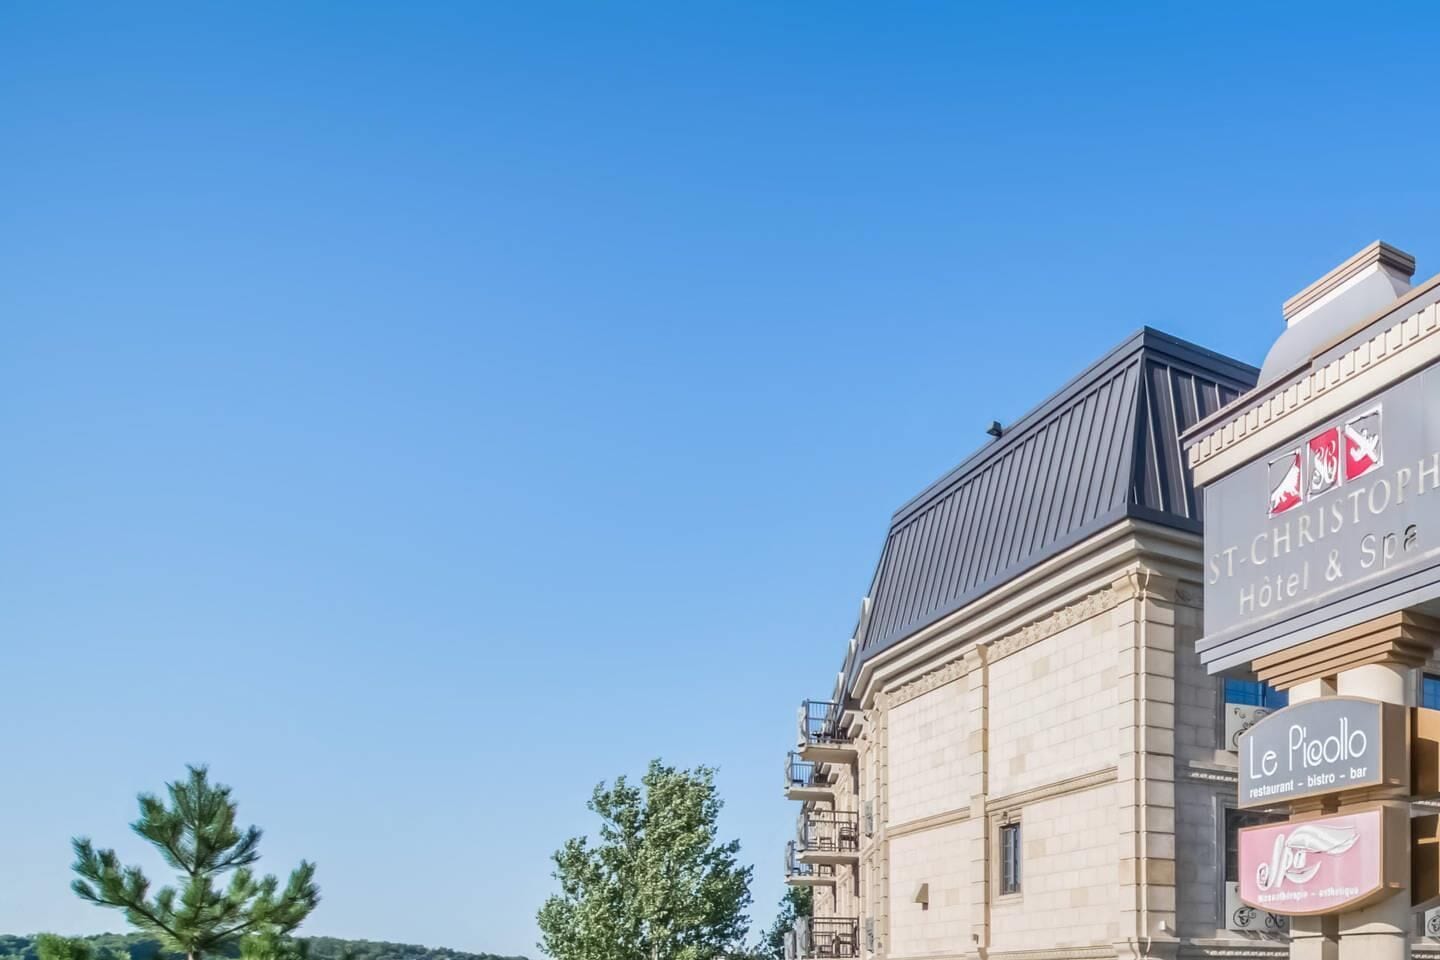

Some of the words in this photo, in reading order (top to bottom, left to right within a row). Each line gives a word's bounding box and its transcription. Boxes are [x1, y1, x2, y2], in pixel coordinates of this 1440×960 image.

[1239, 561, 1309, 616] Hôtel
[1325, 549, 1344, 582] &
[1359, 523, 1419, 569] Spa
[1249, 735, 1278, 780] Le
[1249, 779, 1294, 799] restaurant
[1307, 772, 1336, 788] bistro
[1350, 766, 1368, 780] bar
[1256, 832, 1308, 892] Spa
